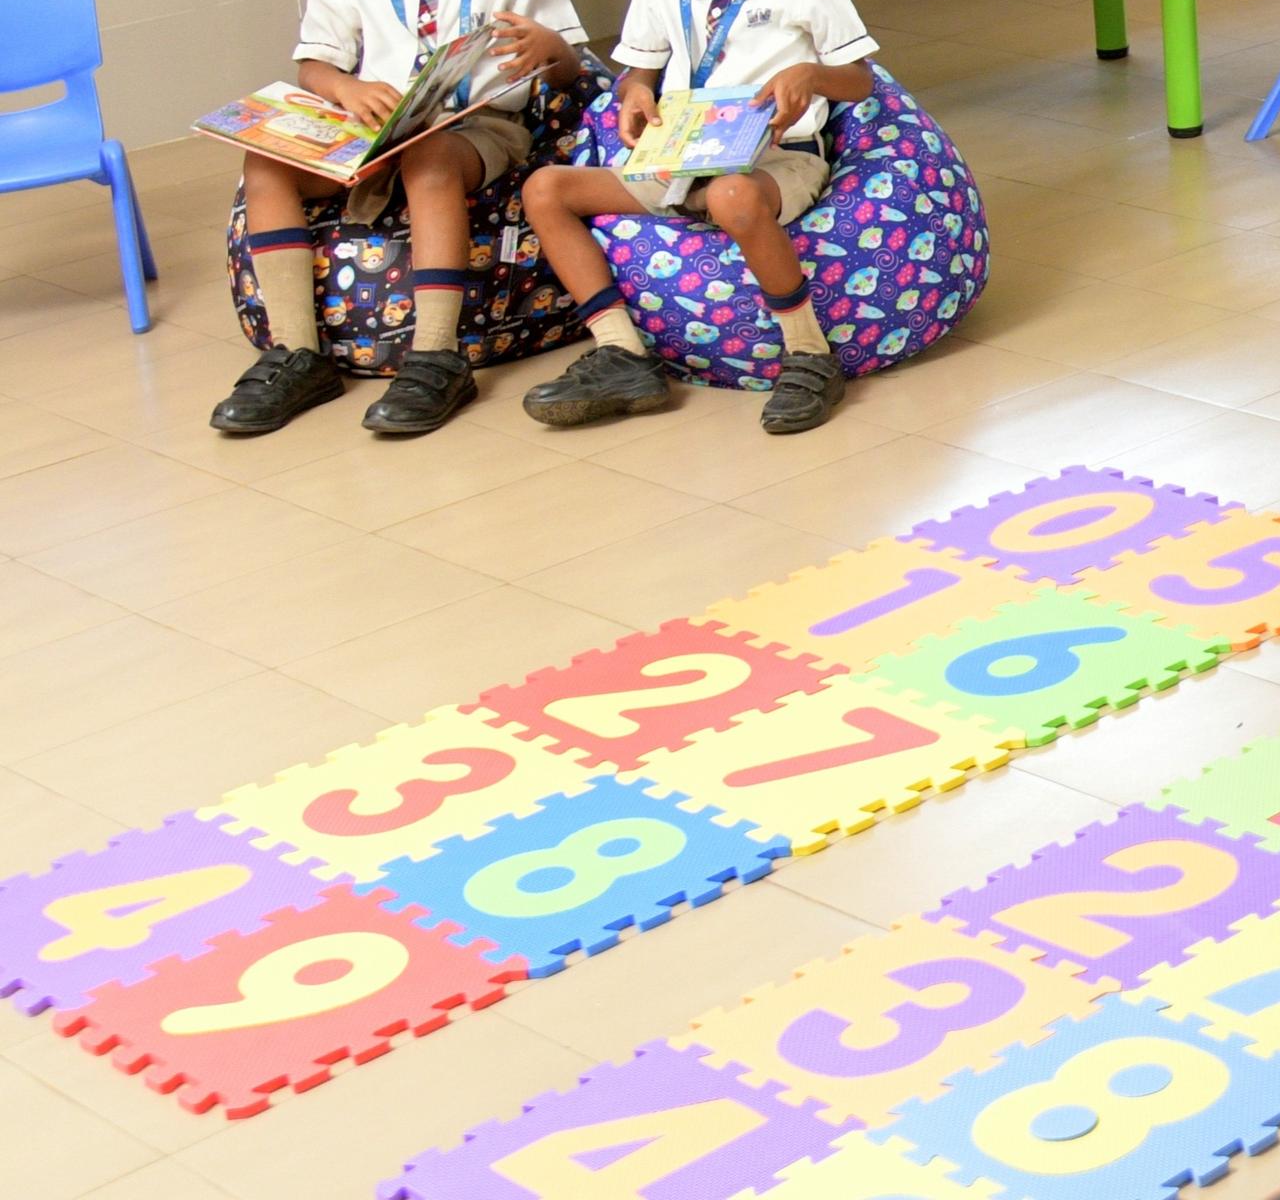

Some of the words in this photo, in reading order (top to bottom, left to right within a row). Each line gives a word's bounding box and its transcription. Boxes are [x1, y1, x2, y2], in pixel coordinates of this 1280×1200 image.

[989, 492, 1156, 554] 0
[808, 567, 961, 637] 1
[944, 626, 1127, 696] 6
[543, 652, 753, 739] 2
[723, 707, 941, 787] 7
[301, 747, 517, 837] 3
[463, 818, 688, 918] 8
[991, 838, 1239, 961] 2
[39, 864, 253, 962] 4
[160, 931, 410, 1036] 9
[777, 958, 1027, 1078] 3
[971, 1037, 1231, 1176] 8
